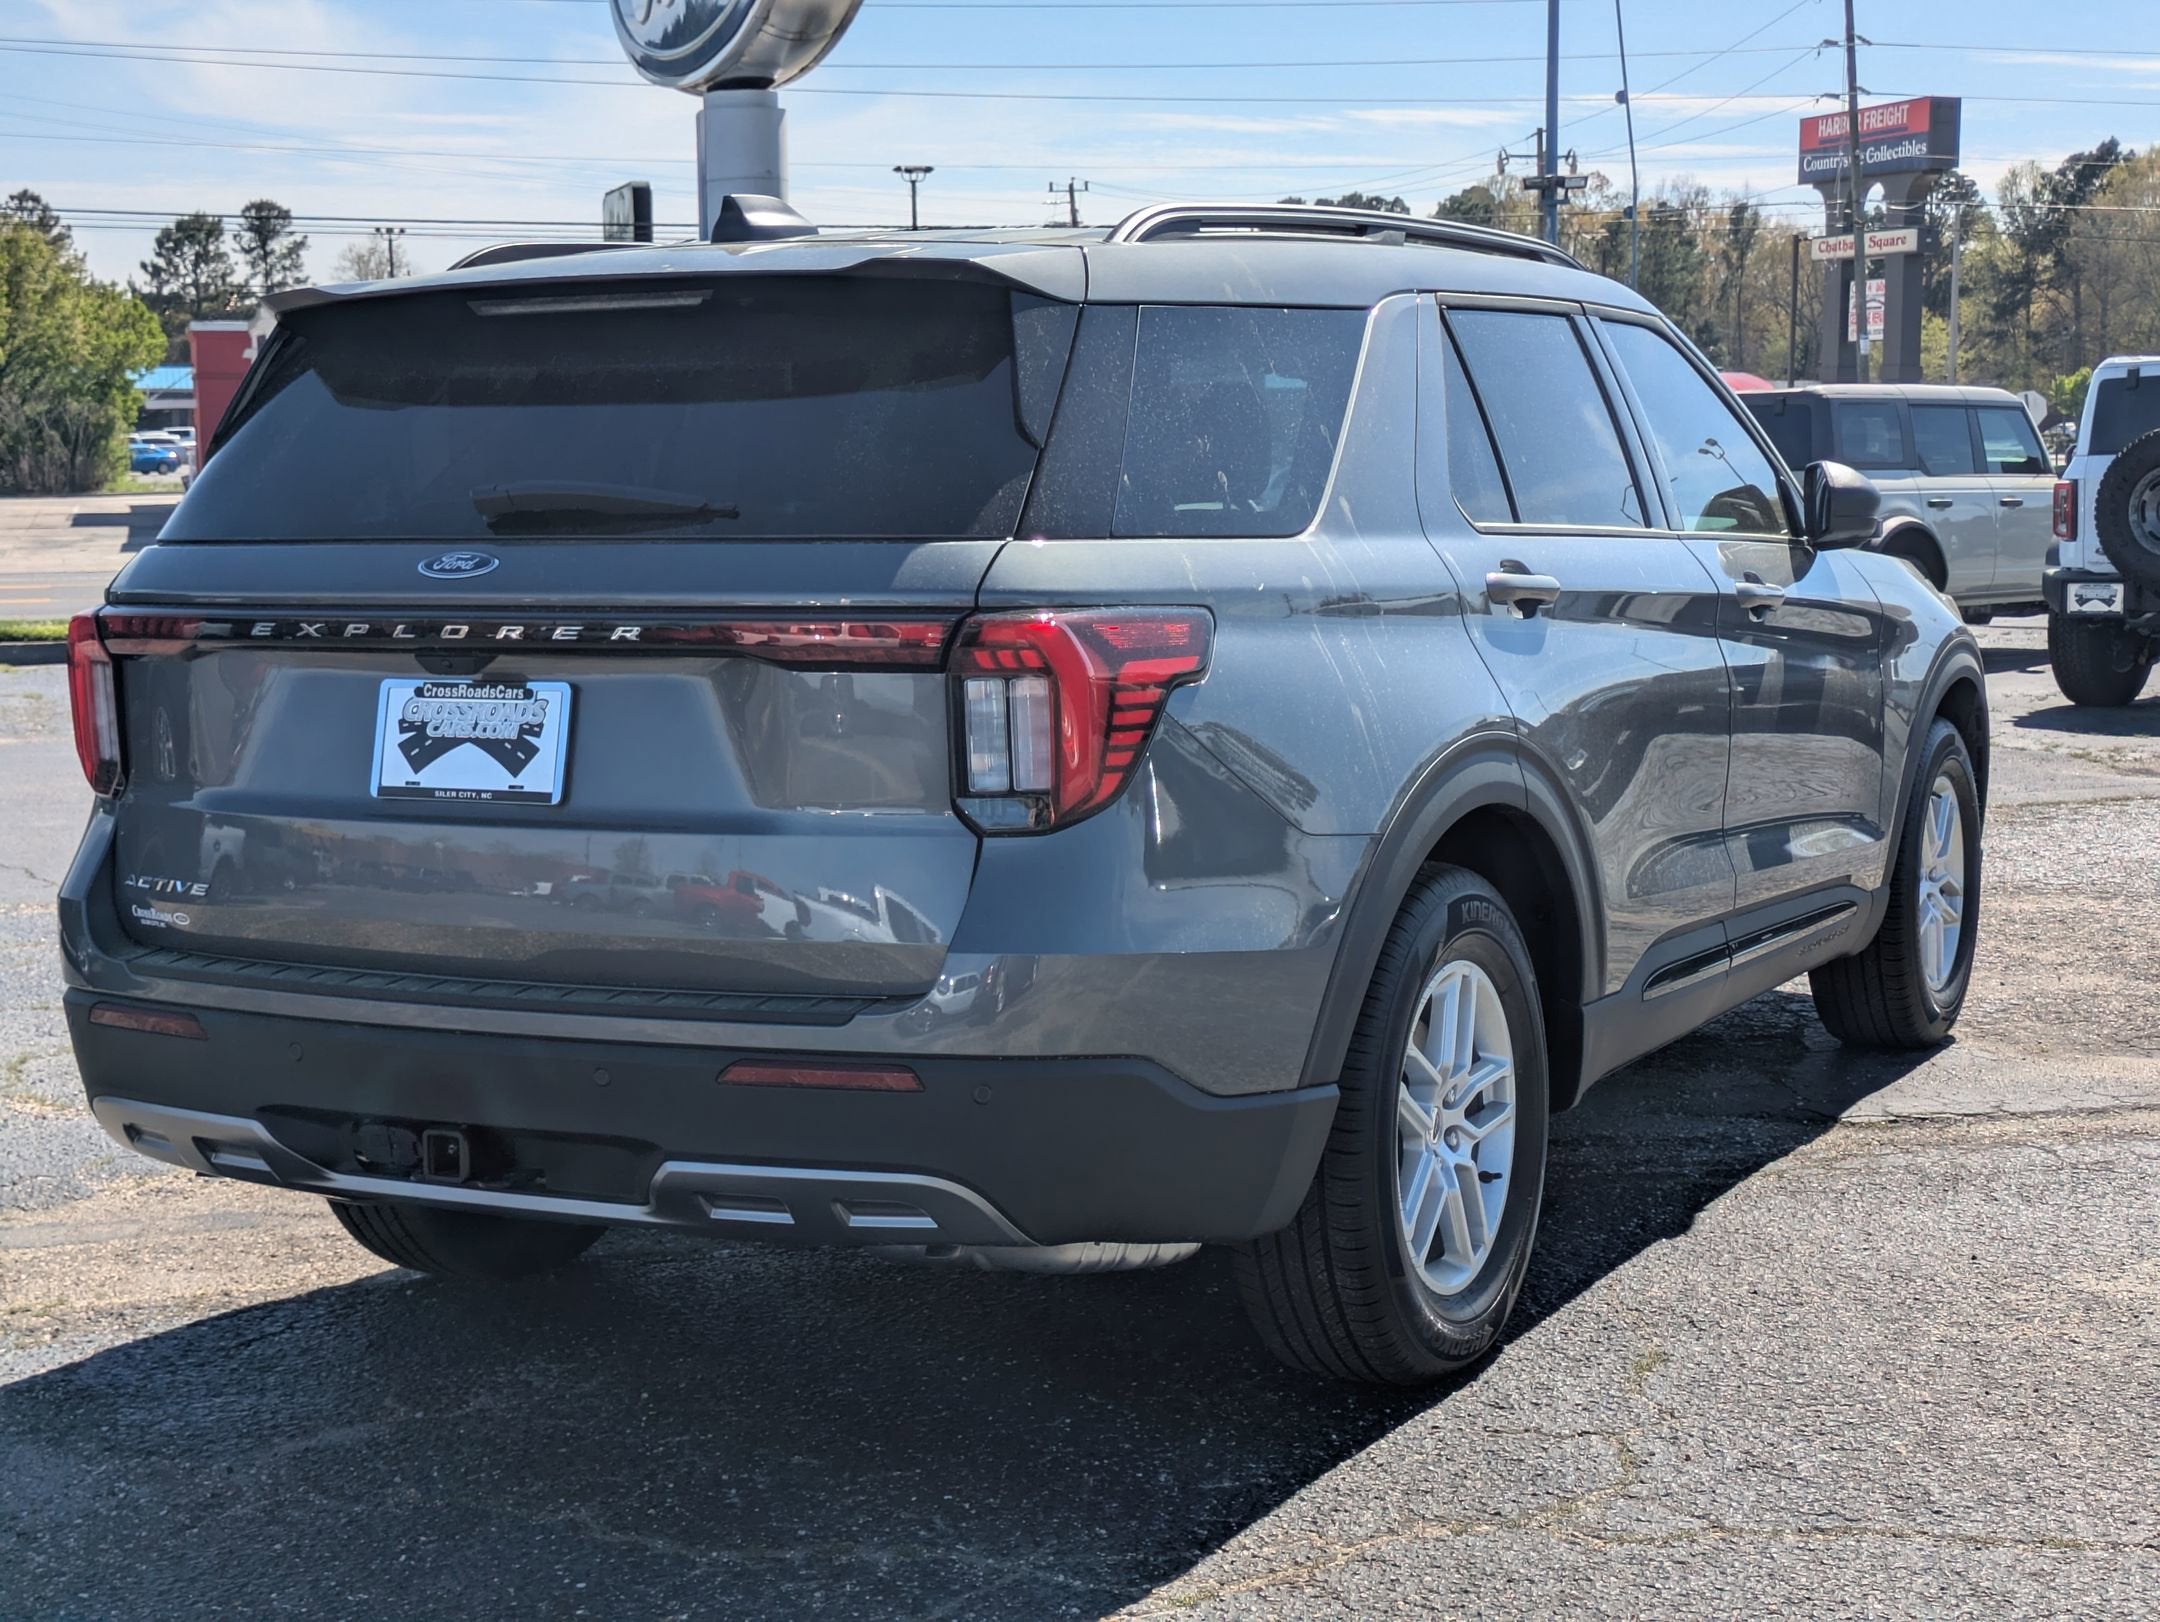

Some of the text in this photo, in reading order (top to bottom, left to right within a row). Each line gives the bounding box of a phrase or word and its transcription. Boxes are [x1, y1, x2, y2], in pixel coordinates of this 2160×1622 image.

[1863, 104, 1910, 131] FREIGHT
[1803, 139, 1928, 172] Countryse Collectibles
[1818, 234, 1907, 254] Chatha Square
[432, 553, 480, 570] Ford
[250, 621, 642, 641] EXPLORER
[422, 683, 525, 699] CrossRoadsCars
[402, 697, 550, 725] CROSSROADS
[434, 789, 458, 798] SILER
[480, 791, 493, 800] NC
[123, 873, 211, 897] ACTIVE
